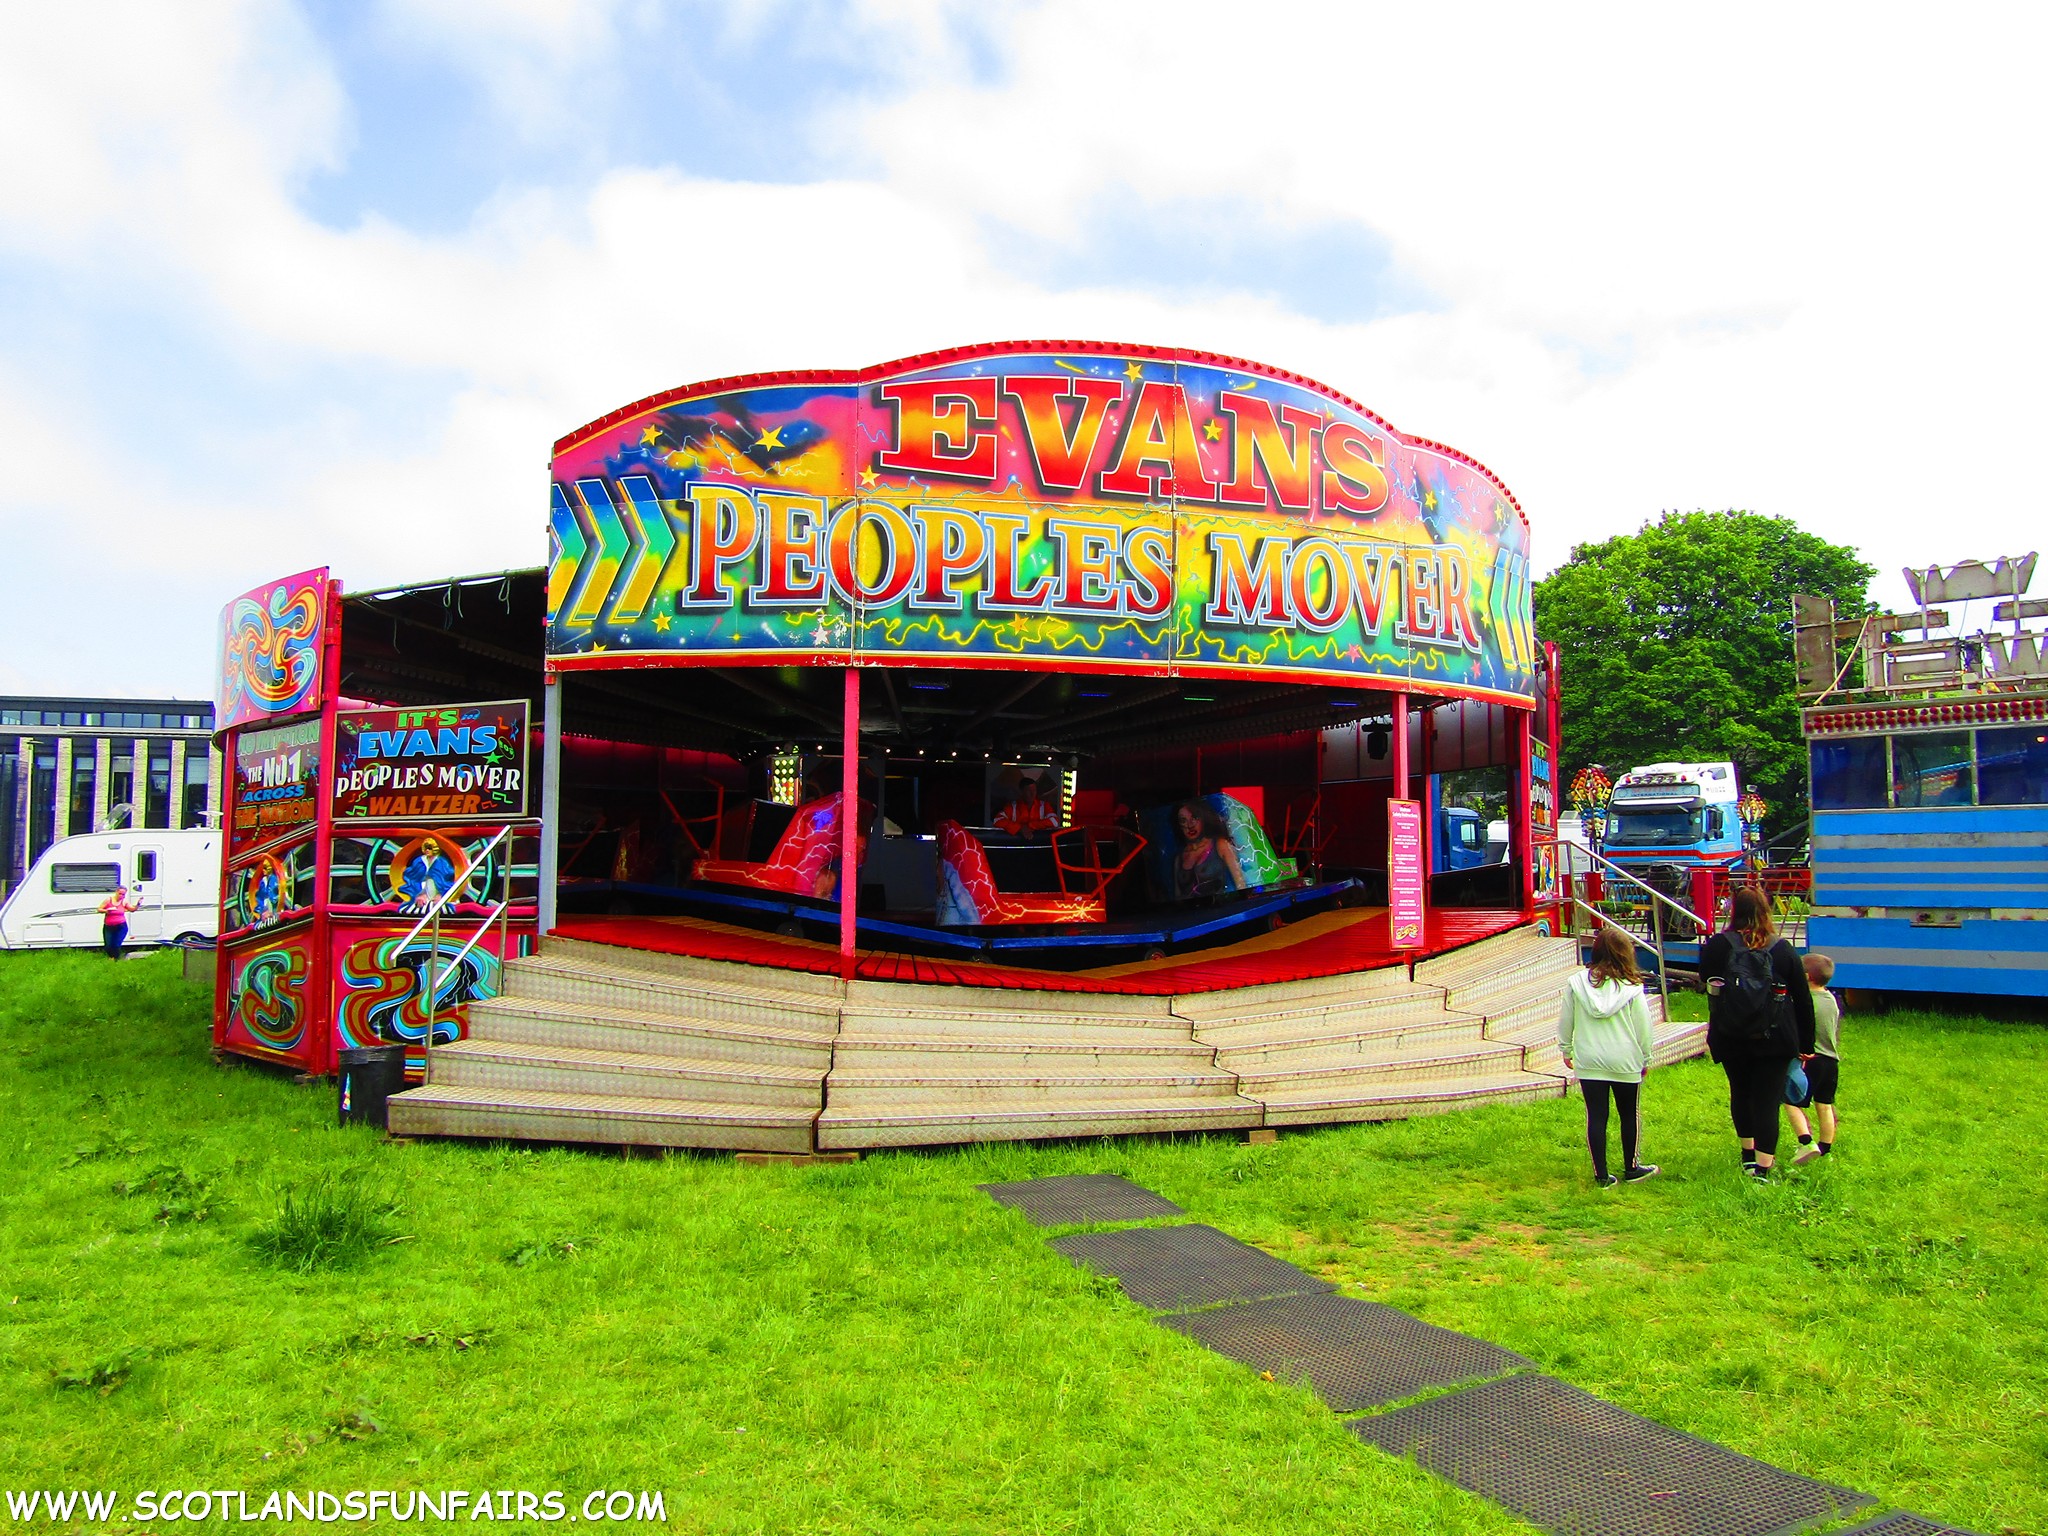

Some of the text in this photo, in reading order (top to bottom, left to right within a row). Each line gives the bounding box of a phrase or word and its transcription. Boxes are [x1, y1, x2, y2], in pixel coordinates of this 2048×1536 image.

[878, 375, 1390, 516] EVANS
[681, 480, 1483, 655] PEOPLES MOVER
[396, 709, 459, 729] IT'S
[358, 725, 498, 758] EVANS
[248, 749, 302, 787] THE NO.1
[335, 763, 521, 798] PEOPLES MOVER
[242, 784, 306, 803] ACROSS
[369, 794, 482, 816] WALTZER
[236, 797, 315, 829] THE NATION
